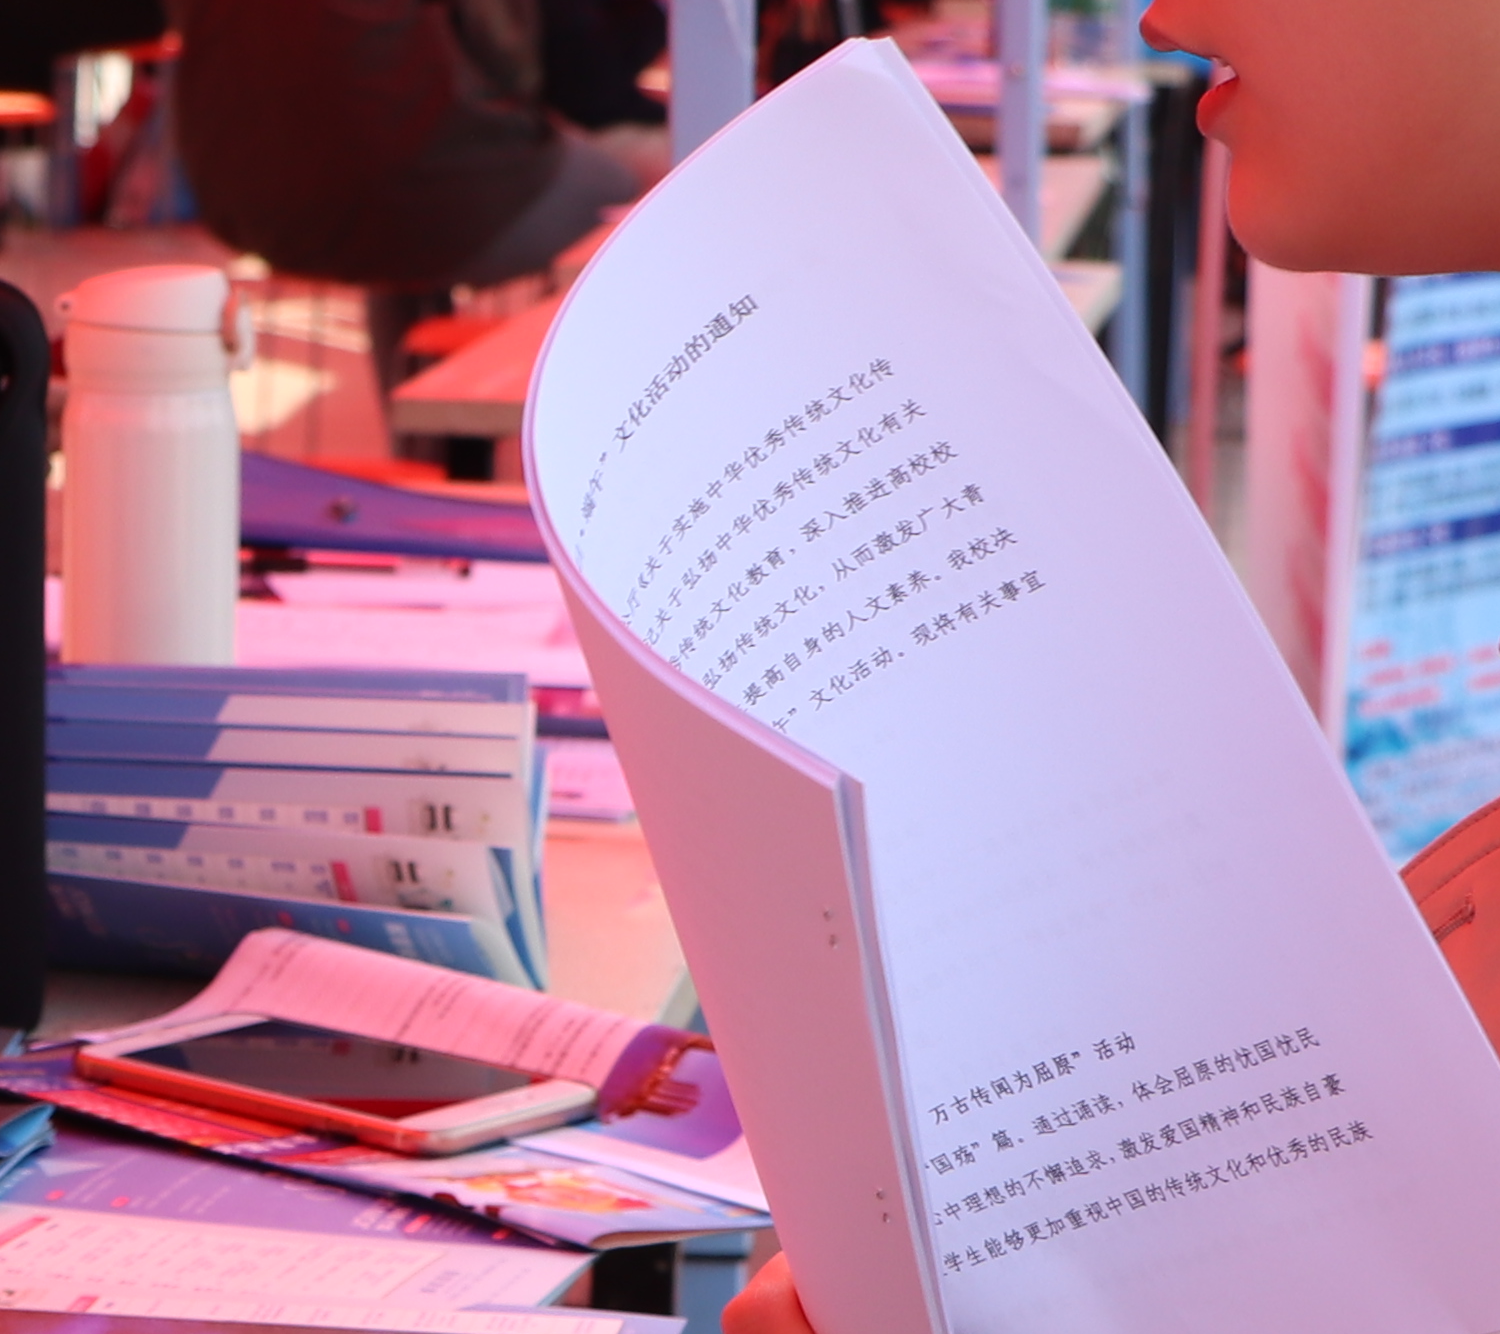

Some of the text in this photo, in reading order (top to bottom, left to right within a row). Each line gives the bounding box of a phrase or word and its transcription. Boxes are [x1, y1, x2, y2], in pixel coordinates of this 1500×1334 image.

[736, 526, 1019, 715] 提高自身的人文素养。我校决
[943, 1119, 1375, 1277] 学生能够更加重视中国的传统文化和优秀的民族
